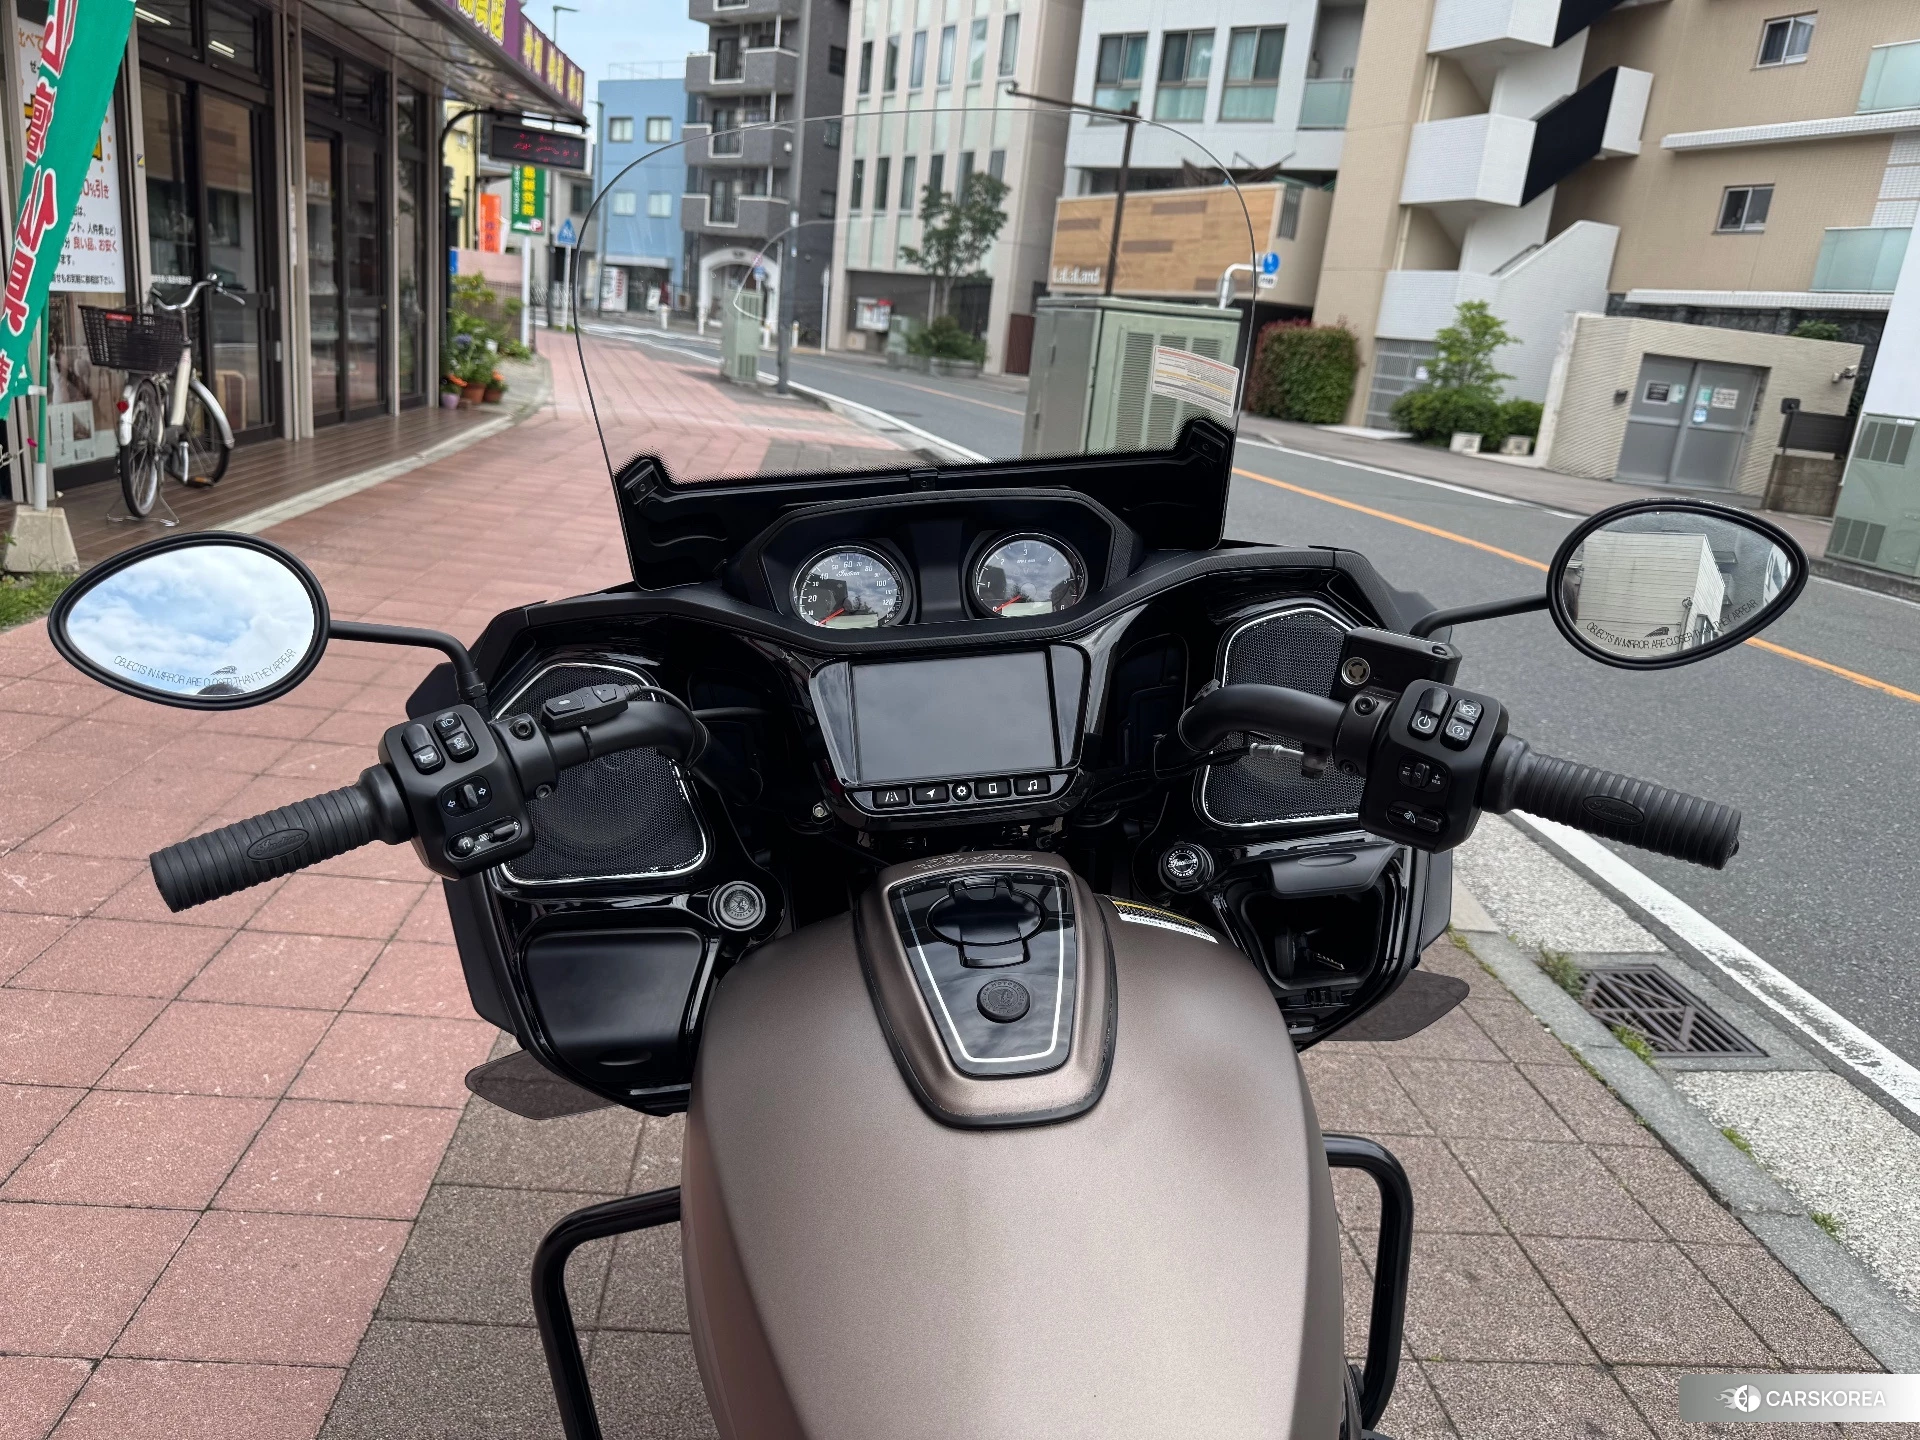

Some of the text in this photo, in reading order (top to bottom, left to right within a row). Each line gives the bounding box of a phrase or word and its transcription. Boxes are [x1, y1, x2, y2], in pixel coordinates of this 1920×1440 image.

[80, 178, 109, 199] 0%引き
[819, 572, 829, 580] 40
[808, 594, 817, 602] 20
[1586, 621, 1615, 643] OBJECTS
[1614, 636, 1623, 647] IN
[1621, 639, 1650, 650] MIRROR
[1651, 639, 1667, 649] ARE
[1713, 614, 1731, 631] THEY
[1731, 599, 1758, 620] APPEAR
[113, 655, 148, 675] OBJECTS
[147, 667, 157, 678] IN
[156, 669, 186, 685] MIRROR
[186, 676, 203, 687] ARE
[254, 665, 274, 681] THEY
[272, 648, 297, 672] APPEAR
[254, 833, 304, 856] Indian
